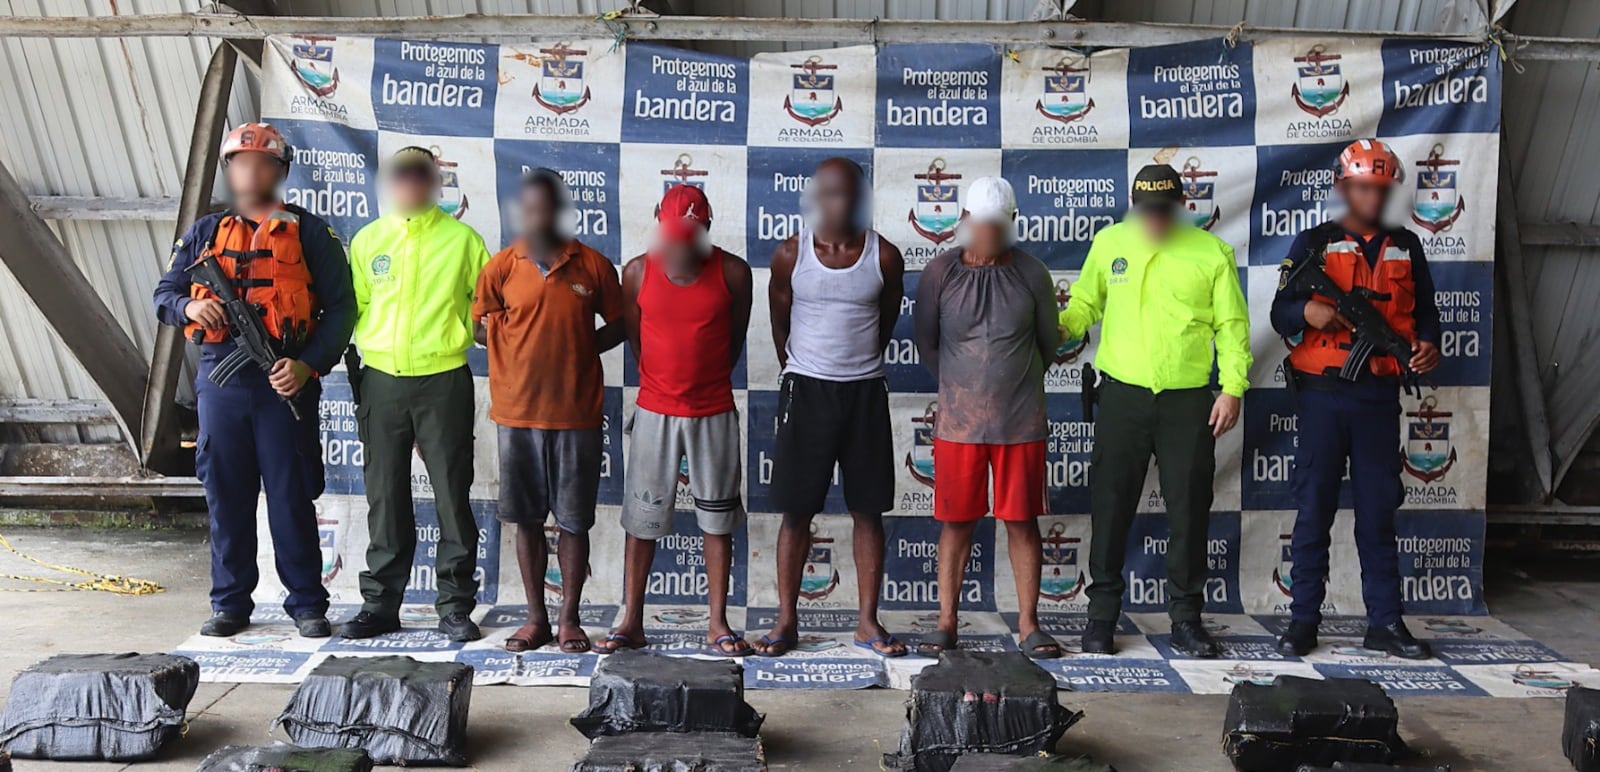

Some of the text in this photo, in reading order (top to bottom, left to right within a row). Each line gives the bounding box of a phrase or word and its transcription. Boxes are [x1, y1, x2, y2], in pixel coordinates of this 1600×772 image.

[400, 42, 485, 64] Protegemos
[425, 65, 485, 80] el azul de la
[652, 56, 736, 78] Protegemos
[1154, 62, 1238, 82] Protegemos
[903, 68, 988, 88] Protegemos
[382, 73, 483, 108] bandera
[677, 78, 736, 94] el azul de la
[928, 87, 987, 100] el azul de la
[1180, 78, 1240, 94] el azul de la
[1394, 76, 1488, 109] bandera
[291, 96, 348, 114] ARMADA
[635, 90, 735, 122] bandera
[887, 98, 987, 126] bandera
[1141, 91, 1244, 118] bandera
[290, 106, 348, 121] DE COLOMBIA
[526, 116, 590, 128] ARMADA
[1288, 118, 1352, 130] ARMADA
[540, 127, 590, 136] COLOMBIA
[779, 128, 843, 138] ARMADA
[1033, 126, 1098, 136] ARMADA
[1302, 130, 1352, 138] COLOMBIA
[1048, 136, 1098, 144] COLOMBIA
[312, 168, 365, 184] el azul de la
[1028, 175, 1114, 196] Protegemos
[285, 182, 368, 218] andera
[582, 189, 594, 203] de
[597, 189, 606, 203] la
[1054, 195, 1115, 208] el azul de la
[1302, 187, 1311, 201] el
[1422, 236, 1466, 248] MADA
[1456, 308, 1468, 322] de
[1471, 308, 1480, 322] la
[320, 418, 354, 432] azul de
[1048, 439, 1056, 452] el
[1060, 438, 1081, 453] azul
[1405, 486, 1456, 496] RMADA
[1408, 496, 1456, 504] COLOMBIA
[676, 552, 686, 566] el
[923, 559, 982, 574] el la
[1218, 556, 1226, 570] la
[1414, 554, 1470, 569] el azul de la
[757, 670, 875, 682] bandera
